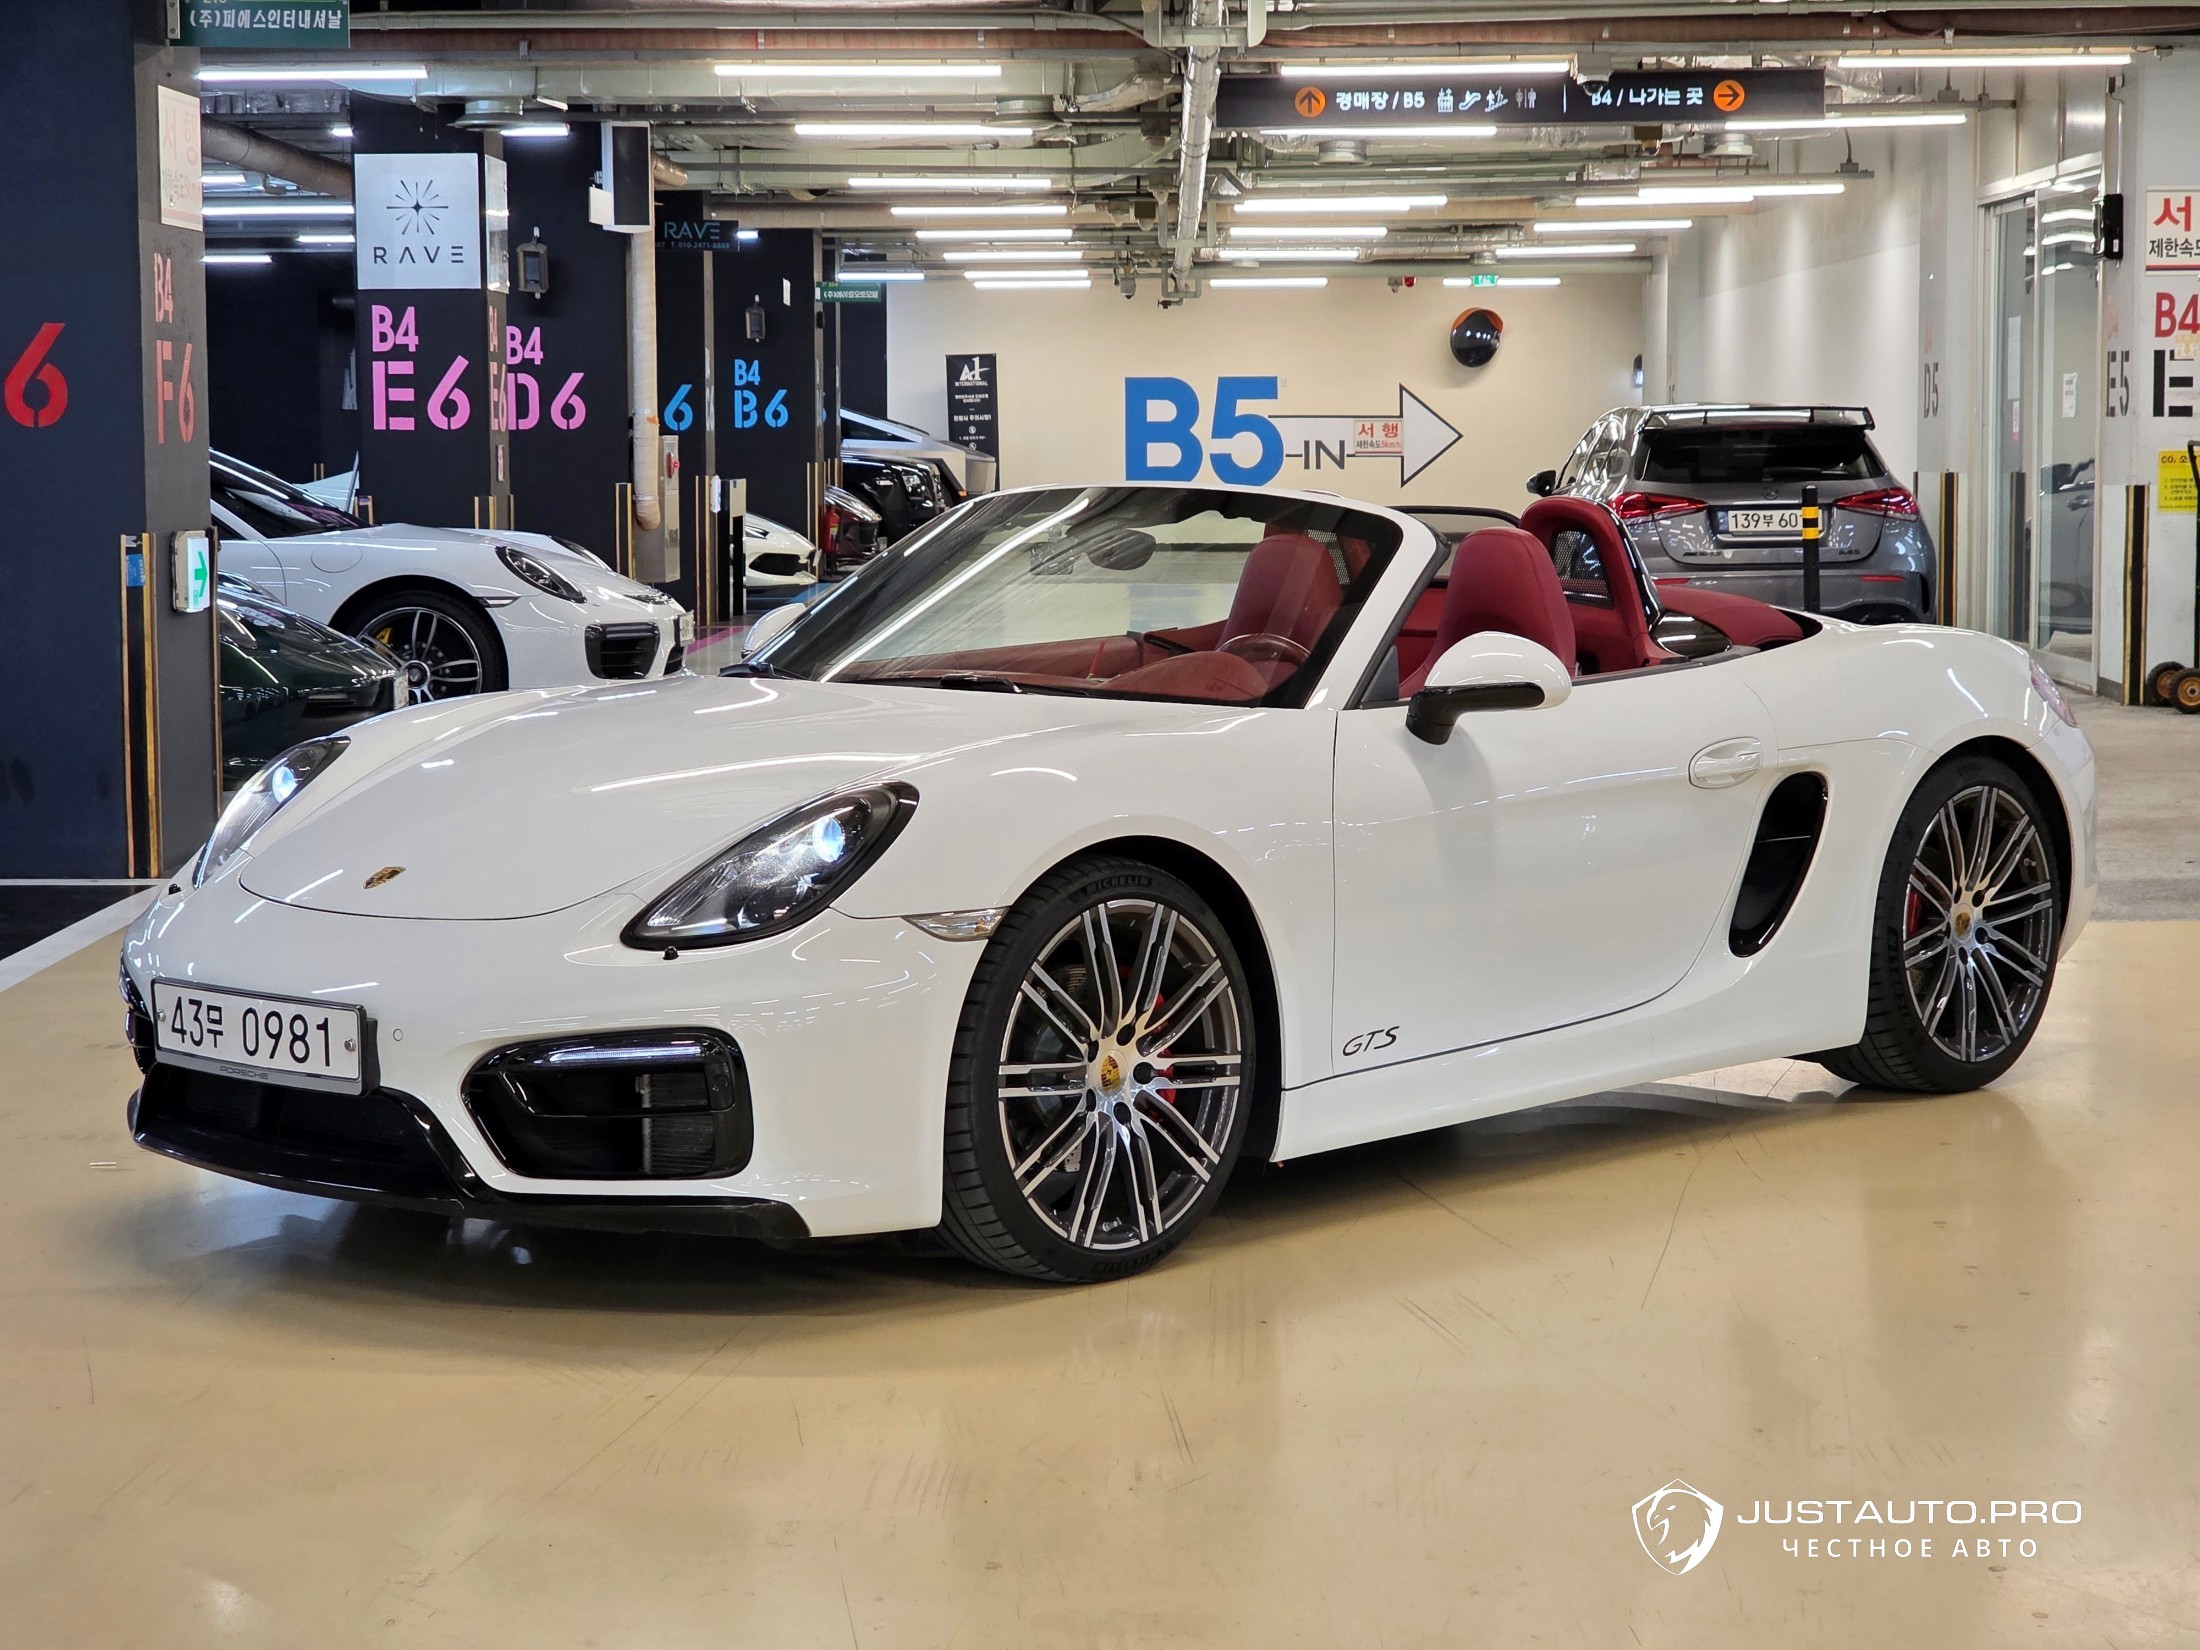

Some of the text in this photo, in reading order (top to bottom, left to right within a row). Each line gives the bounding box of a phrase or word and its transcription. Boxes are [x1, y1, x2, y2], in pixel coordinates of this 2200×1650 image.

[190, 9, 342, 29] (주)피에스인터내셔날
[1336, 91, 1388, 111] 경매장
[1403, 91, 1425, 108] B5
[1629, 87, 1681, 106] 나가는
[1686, 87, 1703, 105] 곳
[664, 221, 720, 239] RAVE
[2153, 196, 2192, 232] 서
[373, 246, 464, 264] RAVE
[154, 252, 173, 324] B4
[372, 305, 418, 352] B4
[2155, 292, 2200, 338] B4
[506, 326, 543, 365] B4
[4, 322, 68, 428] 6
[734, 359, 760, 386] B4
[373, 355, 470, 430] E6
[663, 384, 693, 431] 6
[734, 389, 789, 428] B6
[1125, 376, 1345, 486] B5 IN
[1358, 422, 1398, 438] 서 행
[1731, 512, 1774, 529] 139부
[171, 996, 330, 1067] 43무 0981
[1343, 1026, 1400, 1056] GTS
[220, 1065, 269, 1080] PORSCHE
